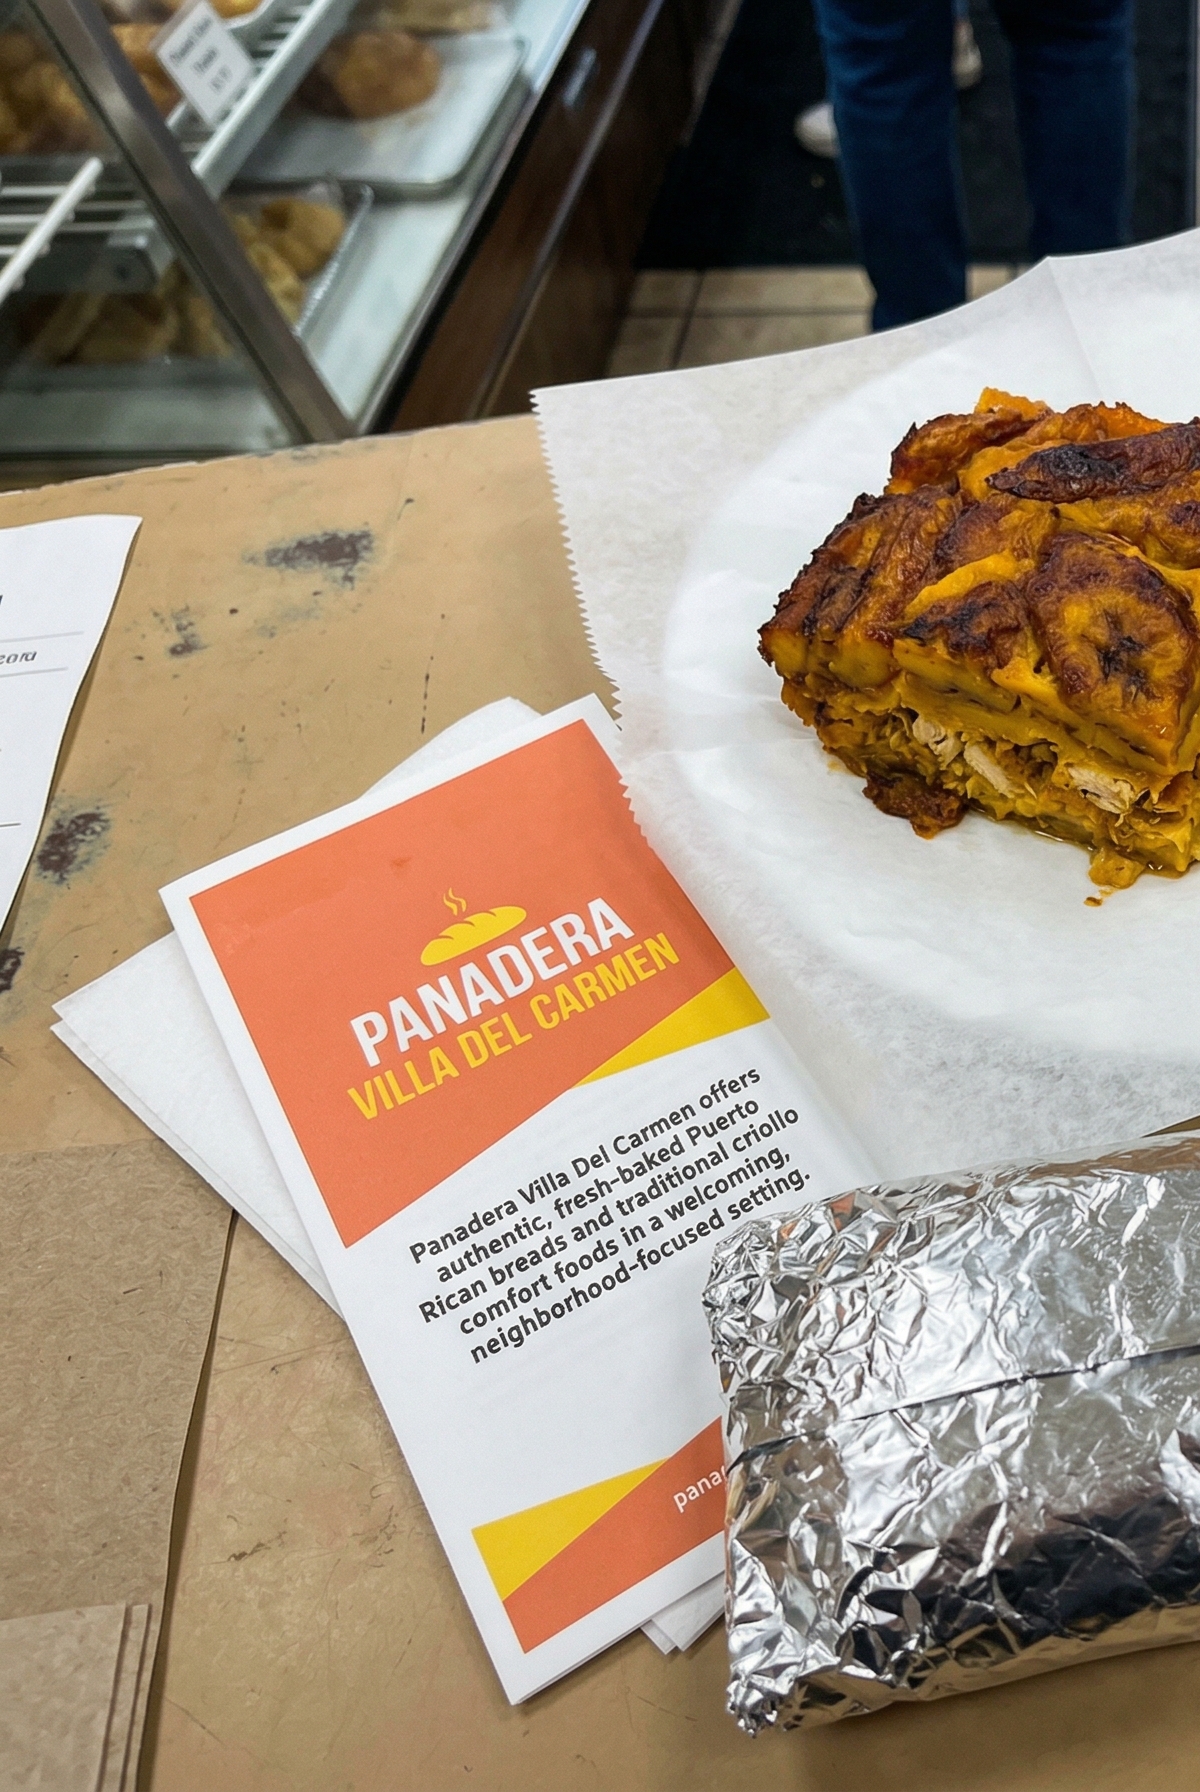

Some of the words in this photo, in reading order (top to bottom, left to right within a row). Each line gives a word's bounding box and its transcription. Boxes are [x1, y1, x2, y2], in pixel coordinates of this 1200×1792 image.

[346, 1046, 460, 1120] VILLA
[456, 1011, 533, 1069] DEL
[529, 932, 680, 1030] CARMEN
[350, 897, 635, 1067] PANADERA
[409, 1200, 519, 1264] Panadera
[517, 1172, 571, 1205] Villa
[571, 1144, 611, 1179] Del
[613, 1104, 697, 1155] Carmen
[699, 1069, 761, 1109] offers
[418, 1279, 488, 1324] Rican
[488, 1235, 568, 1286] breads
[570, 1204, 615, 1243] and
[615, 1141, 730, 1217] traditional
[732, 1109, 799, 1153] criollo
[437, 1216, 553, 1283] authentic,
[553, 1134, 686, 1220] fresh-baked
[685, 1100, 759, 1147] Puerto
[460, 1273, 553, 1335] comfort
[553, 1239, 620, 1284] foods
[619, 1225, 647, 1247] in
[648, 1215, 664, 1232] a
[663, 1147, 790, 1221] welcoming,
[470, 1207, 725, 1364] neighborhood-focused
[727, 1168, 810, 1221] setting.
